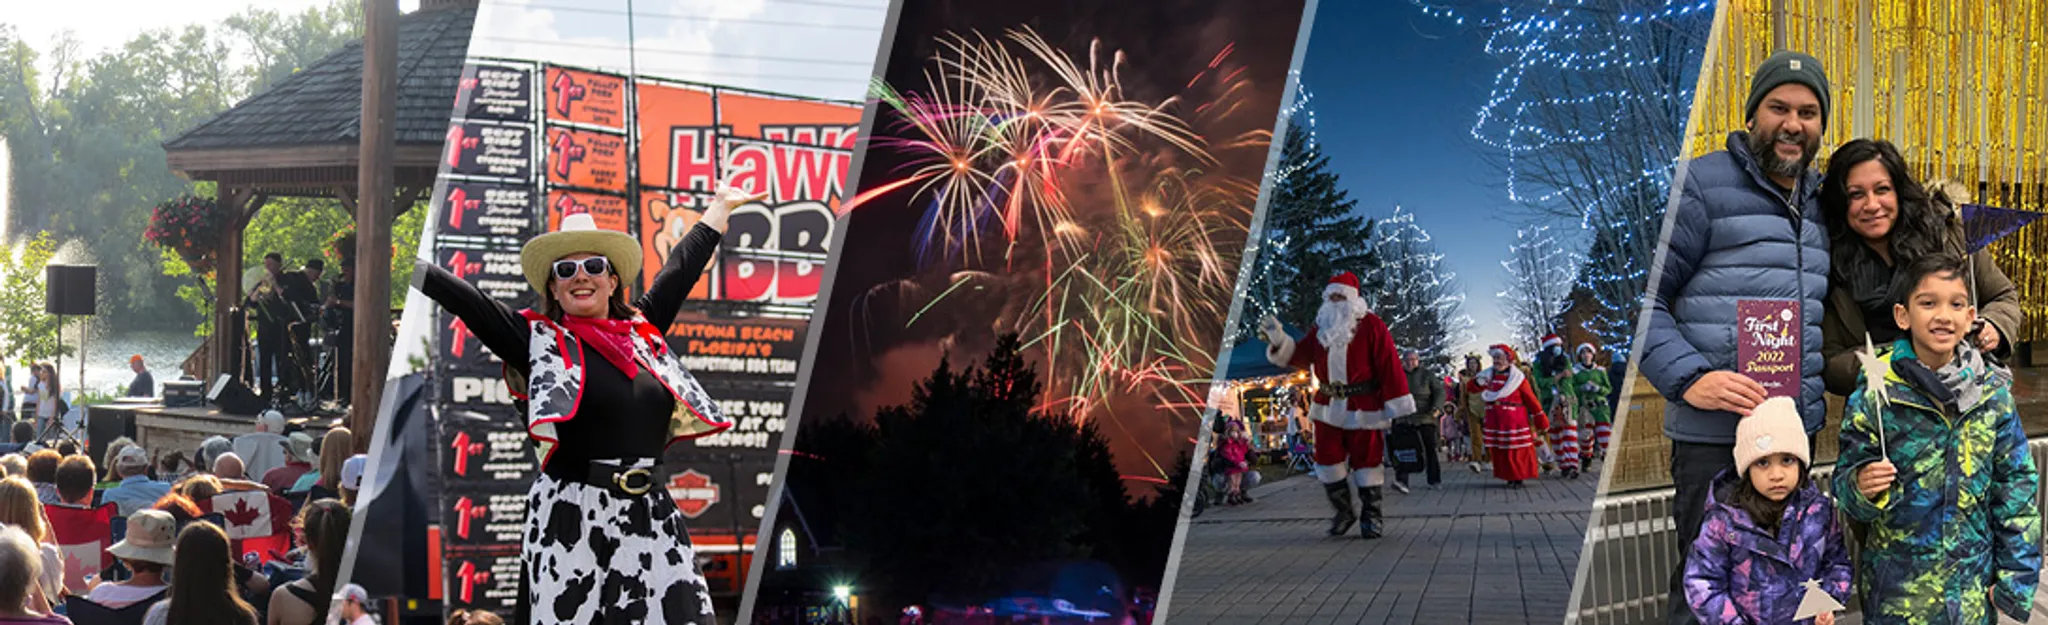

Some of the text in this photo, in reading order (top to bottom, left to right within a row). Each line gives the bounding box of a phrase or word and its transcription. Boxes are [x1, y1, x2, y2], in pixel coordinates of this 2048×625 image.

[447, 187, 480, 230] 1ST
[1744, 316, 1779, 332] First
[740, 325, 795, 342] BEACH
[1752, 332, 1794, 350] Night
[1756, 351, 1785, 362] 2022
[1745, 361, 1794, 375] Passport
[748, 401, 784, 417] YOU
[739, 417, 764, 431] AT
[452, 431, 484, 477] 1ST
[454, 496, 487, 540] 1ST
[456, 560, 490, 605] 1ST
